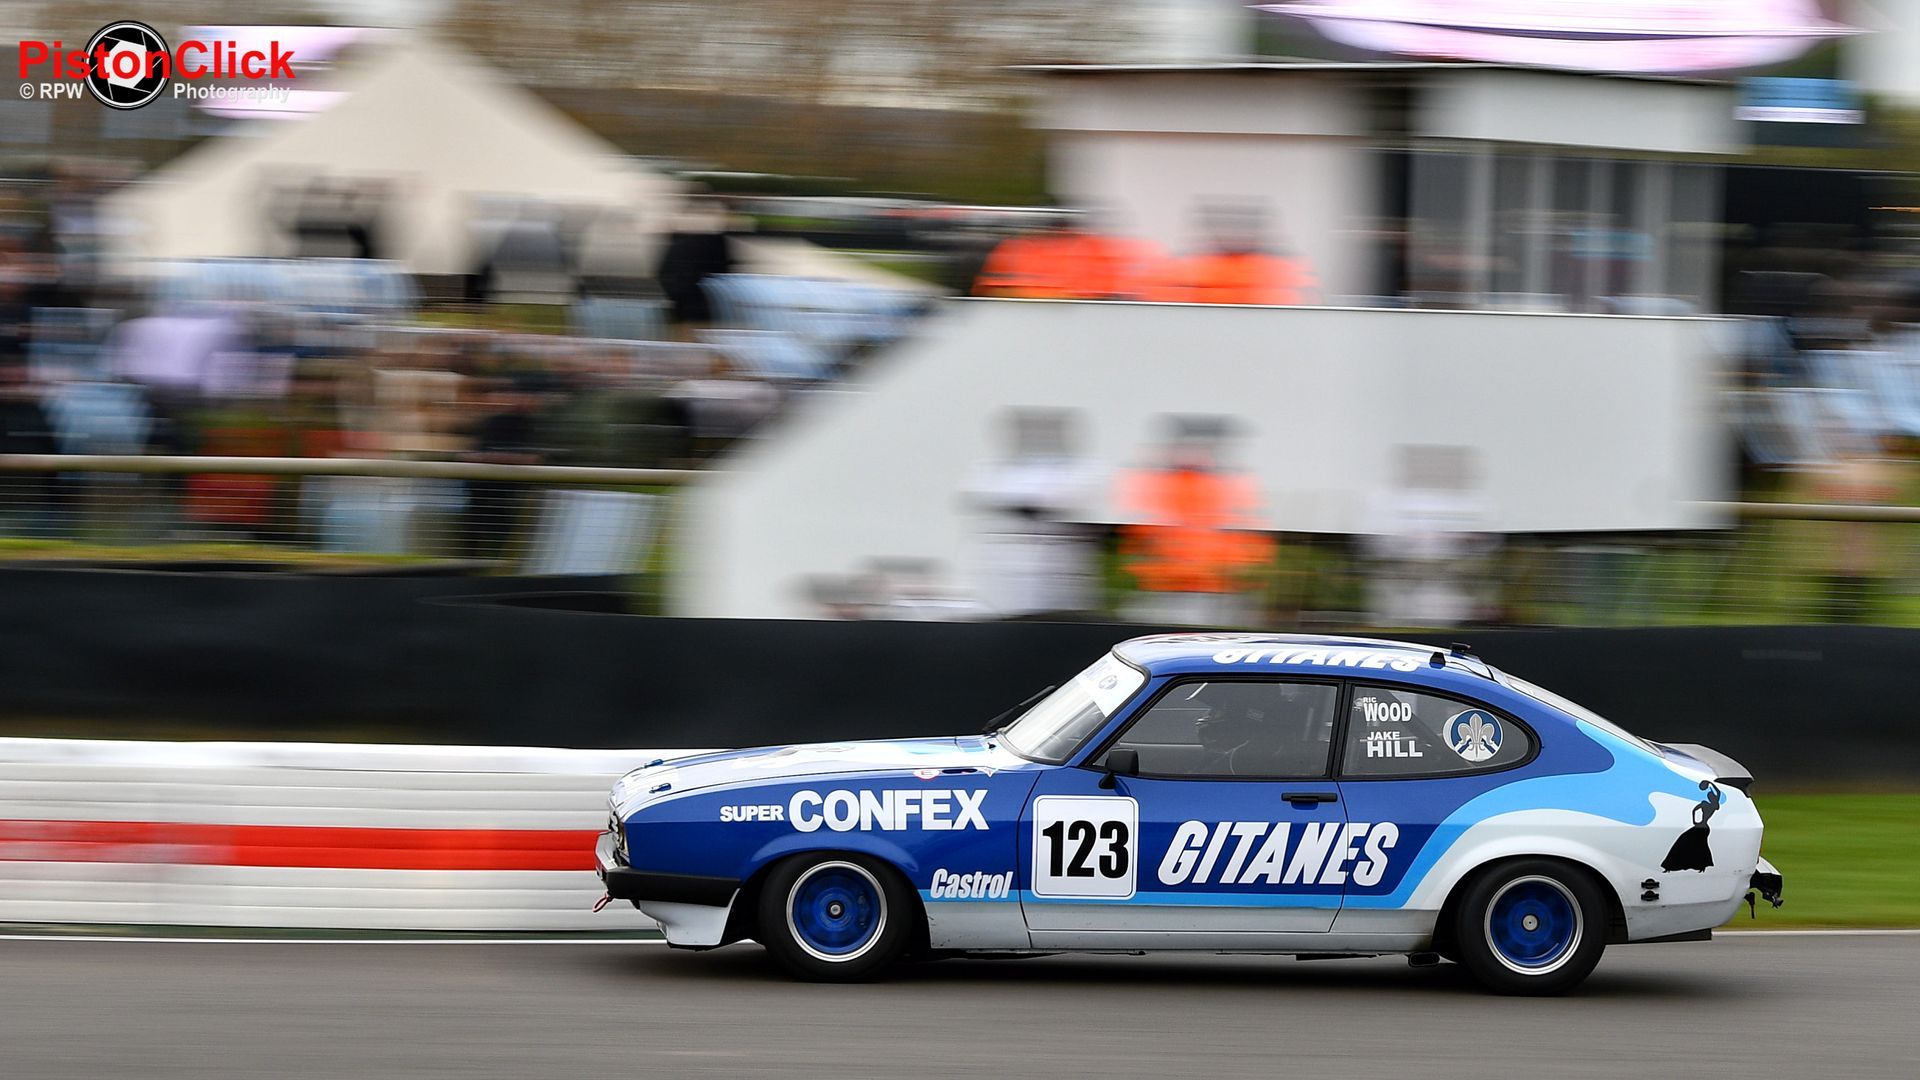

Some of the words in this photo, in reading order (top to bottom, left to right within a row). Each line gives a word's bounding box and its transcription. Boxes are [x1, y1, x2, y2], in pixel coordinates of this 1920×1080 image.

[1363, 702, 1413, 722] WOOD
[1366, 740, 1423, 758] HILL
[1367, 731, 1401, 741] JAKE
[719, 805, 785, 822] SUPER
[788, 789, 990, 833] CONFEX
[1042, 820, 1130, 879] 123
[1157, 820, 1400, 887] GITANES
[929, 868, 1014, 899] Castrol
